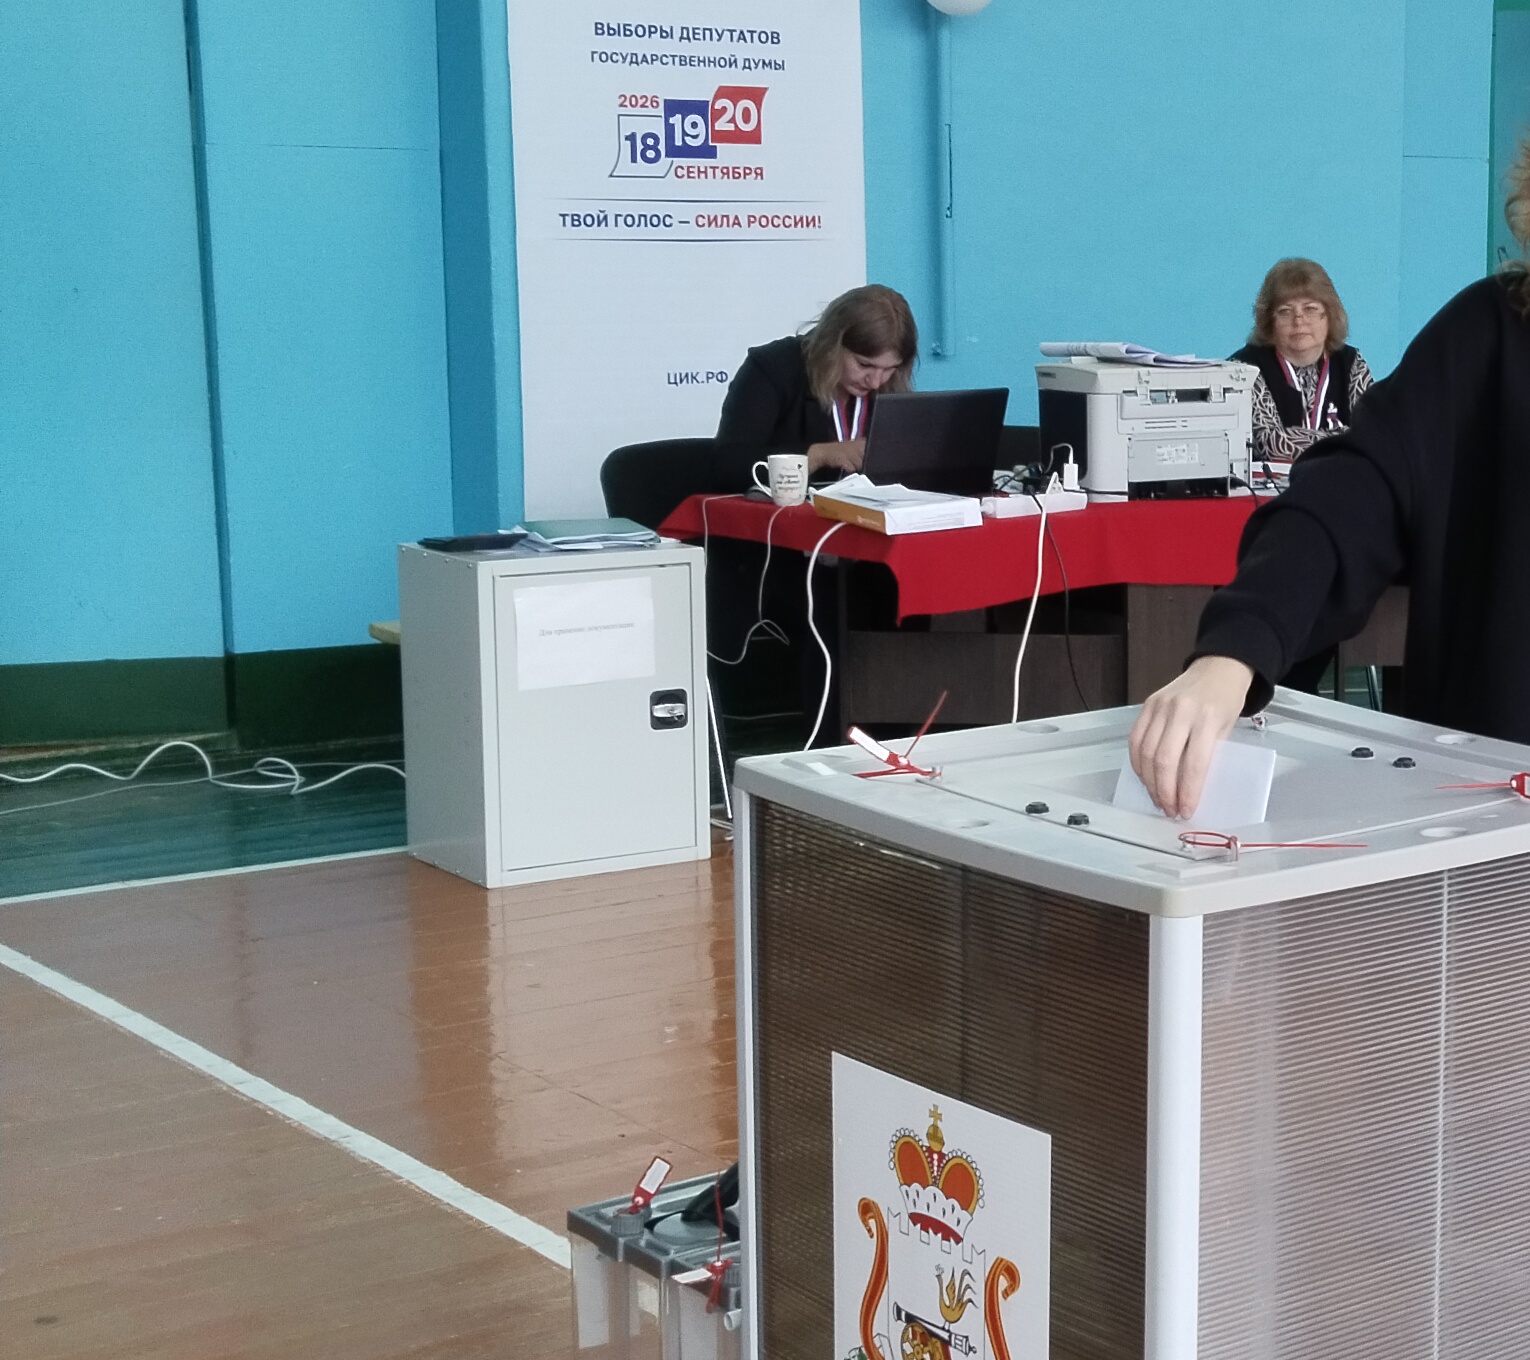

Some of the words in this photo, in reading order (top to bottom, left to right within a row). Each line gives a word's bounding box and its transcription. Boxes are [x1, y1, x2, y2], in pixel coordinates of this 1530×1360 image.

[594, 21, 674, 40] ВЫБОРЫ
[678, 26, 781, 45] ДЕПУТАТОВ
[590, 50, 738, 69] ГОСУДАРСТВЕННОЙ
[741, 57, 786, 71] ДУМЫ
[618, 94, 660, 109] 2026
[624, 131, 662, 165] 18
[669, 114, 706, 147] 19
[714, 98, 758, 132] 20
[674, 165, 764, 181] СЕНТЯБРЯ
[558, 210, 608, 228] ТВОЙ
[614, 213, 673, 229] ГОЛОС
[695, 214, 743, 229] СИЛА
[747, 214, 822, 229] РОССИИ!
[667, 370, 729, 387] ЦИК.РФ
